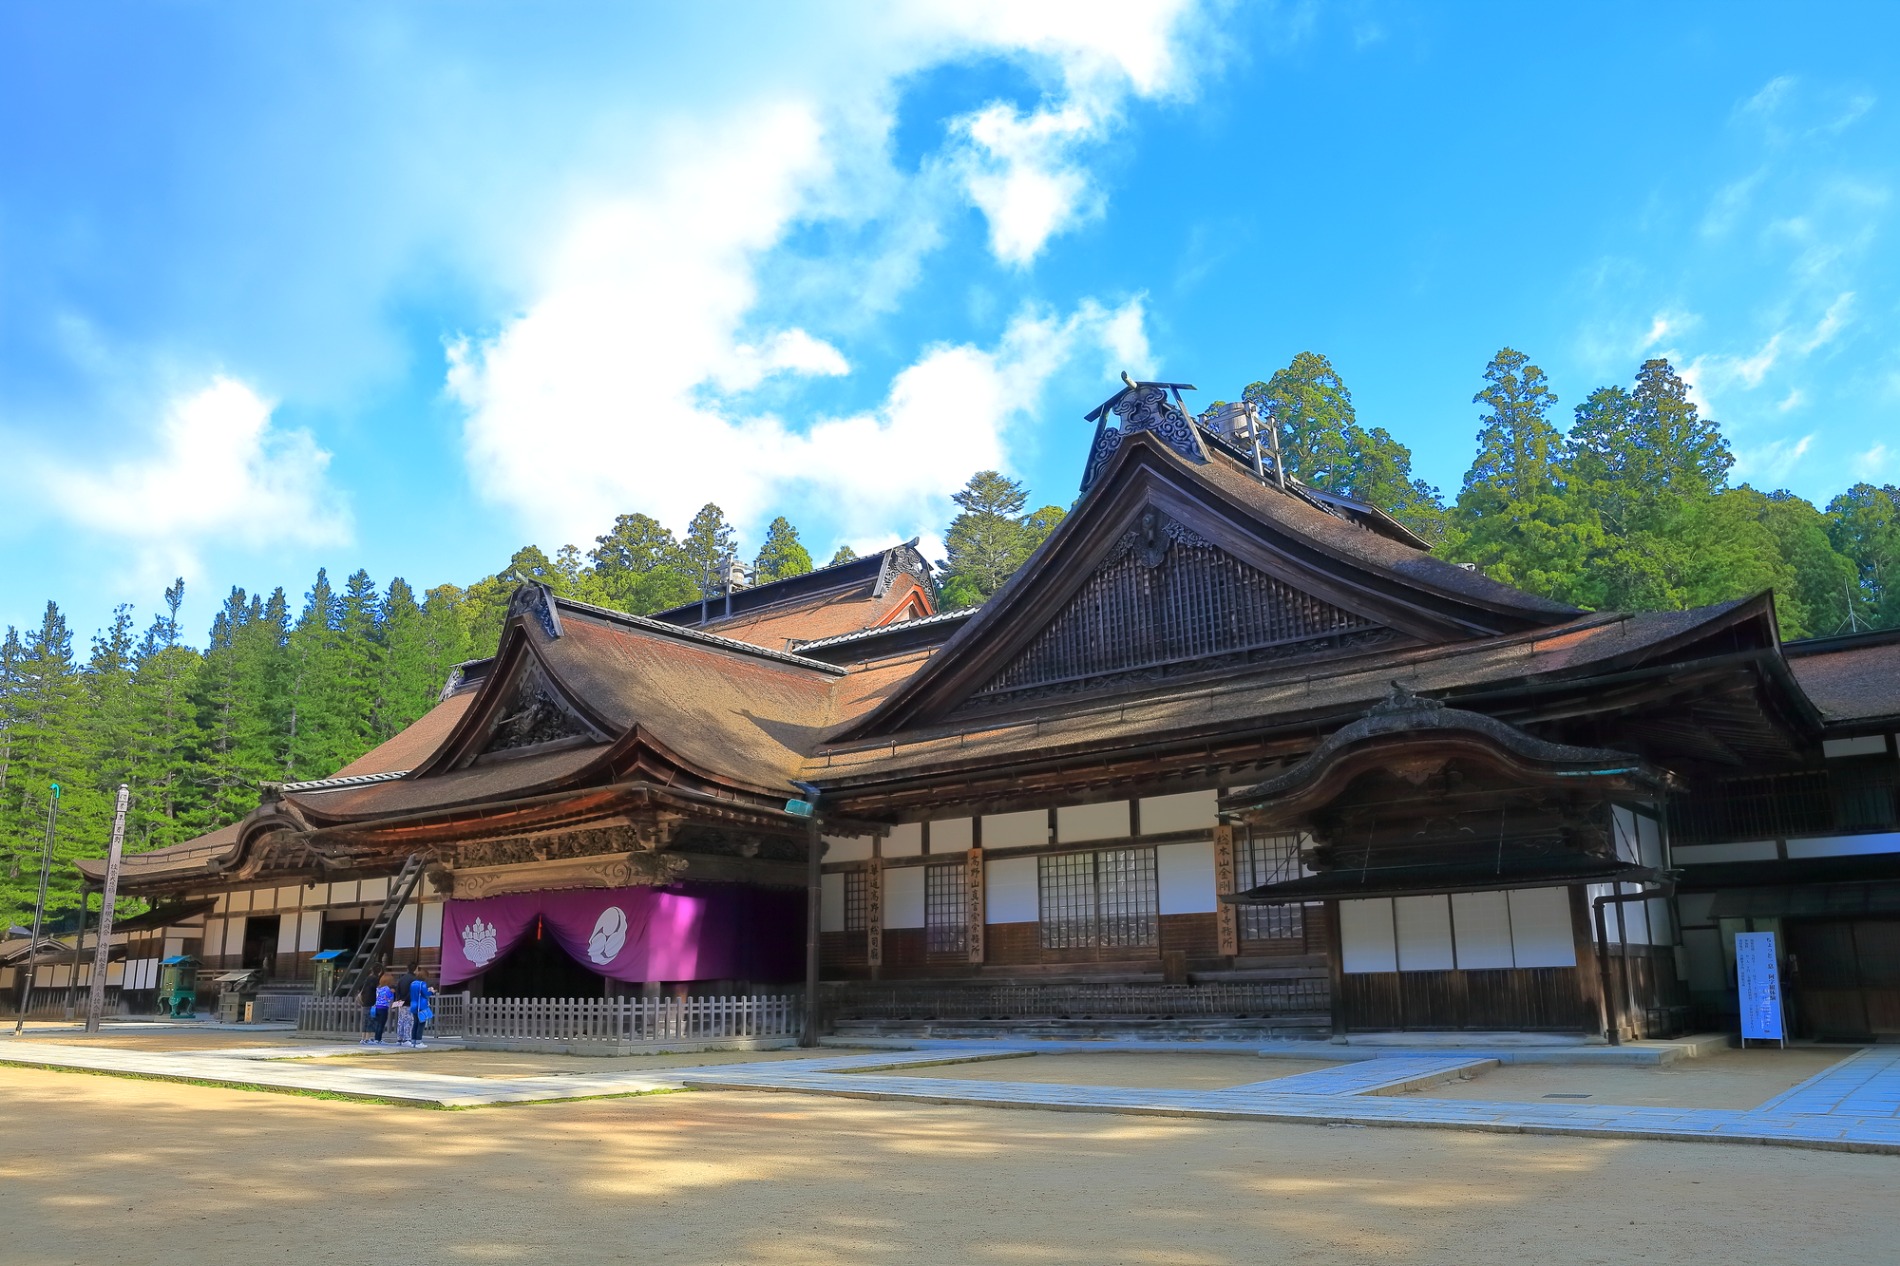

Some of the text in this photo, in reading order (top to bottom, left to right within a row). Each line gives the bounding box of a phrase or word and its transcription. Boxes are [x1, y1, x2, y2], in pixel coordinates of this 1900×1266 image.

[1217, 833, 1233, 949] 総本山金剛寺寺務所
